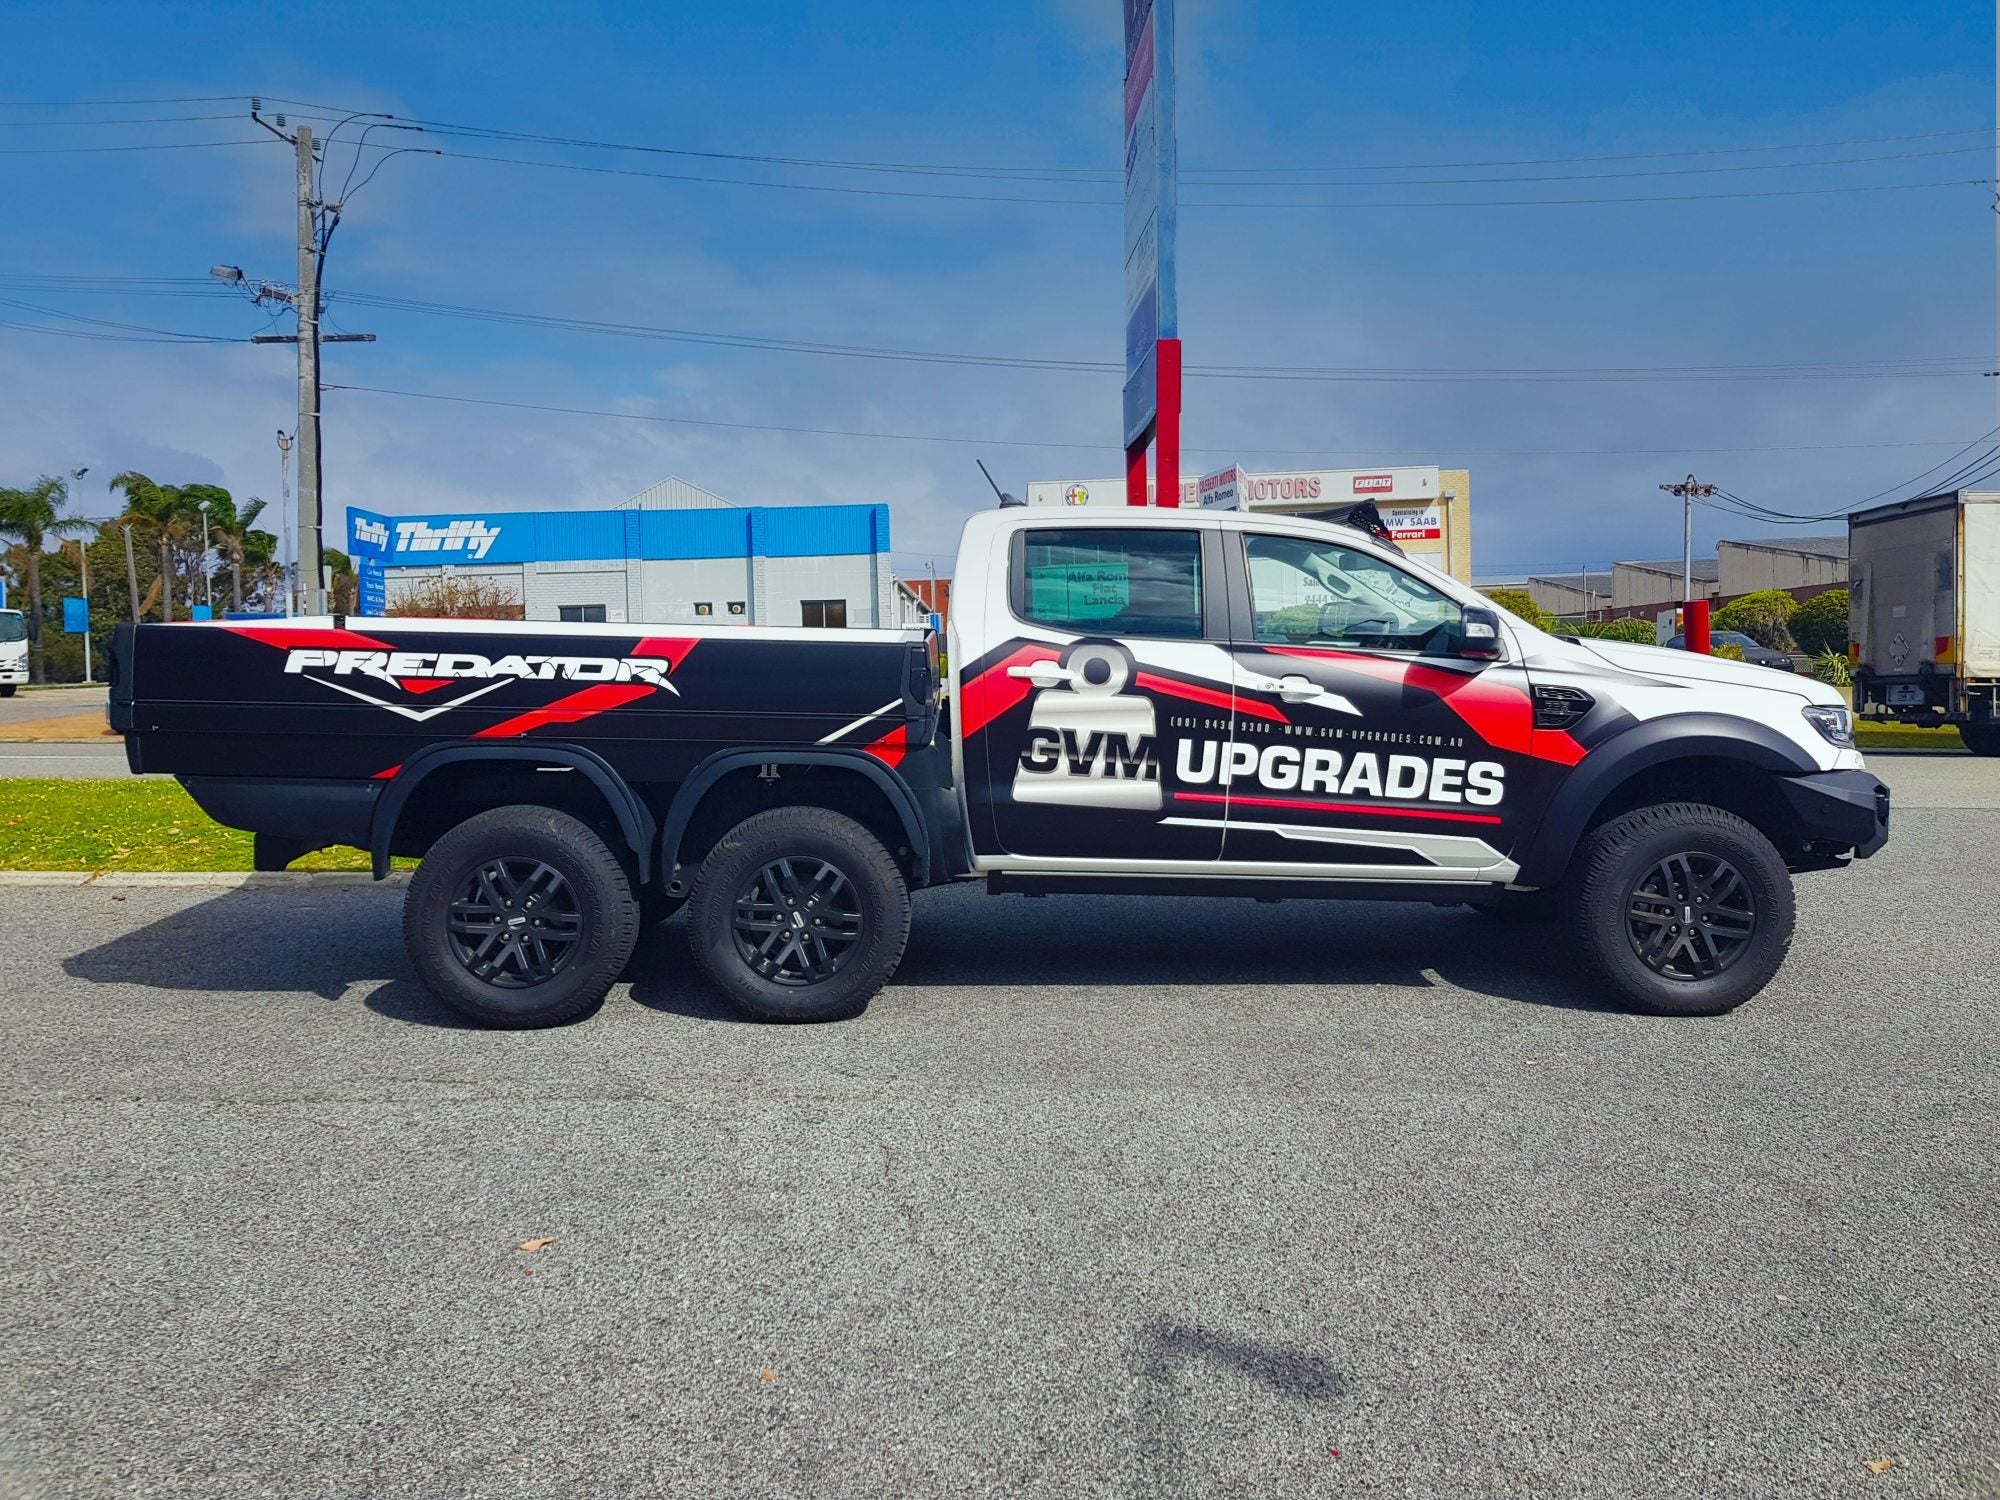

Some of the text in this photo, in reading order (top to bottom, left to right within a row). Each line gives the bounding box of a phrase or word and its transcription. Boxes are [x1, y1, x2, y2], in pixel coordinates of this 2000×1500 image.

[1356, 479, 1390, 487] FIAT
[1203, 493, 1214, 506] Alfa
[1214, 488, 1234, 502] Romeo
[1410, 517, 1437, 526] SAAB
[355, 517, 389, 552] Thrifty
[396, 520, 501, 559] Thrifty
[1391, 530, 1426, 539] Ferrari
[1067, 570, 1093, 582] Alfa
[1092, 583, 1118, 593] Fiat
[1083, 594, 1125, 605] Lancia
[284, 650, 680, 697] PREDATOR
[1204, 719, 1232, 730] 9430
[1241, 721, 1270, 732] 9300
[1019, 726, 1157, 781] GVM
[1175, 738, 1505, 806] UPGRADES
